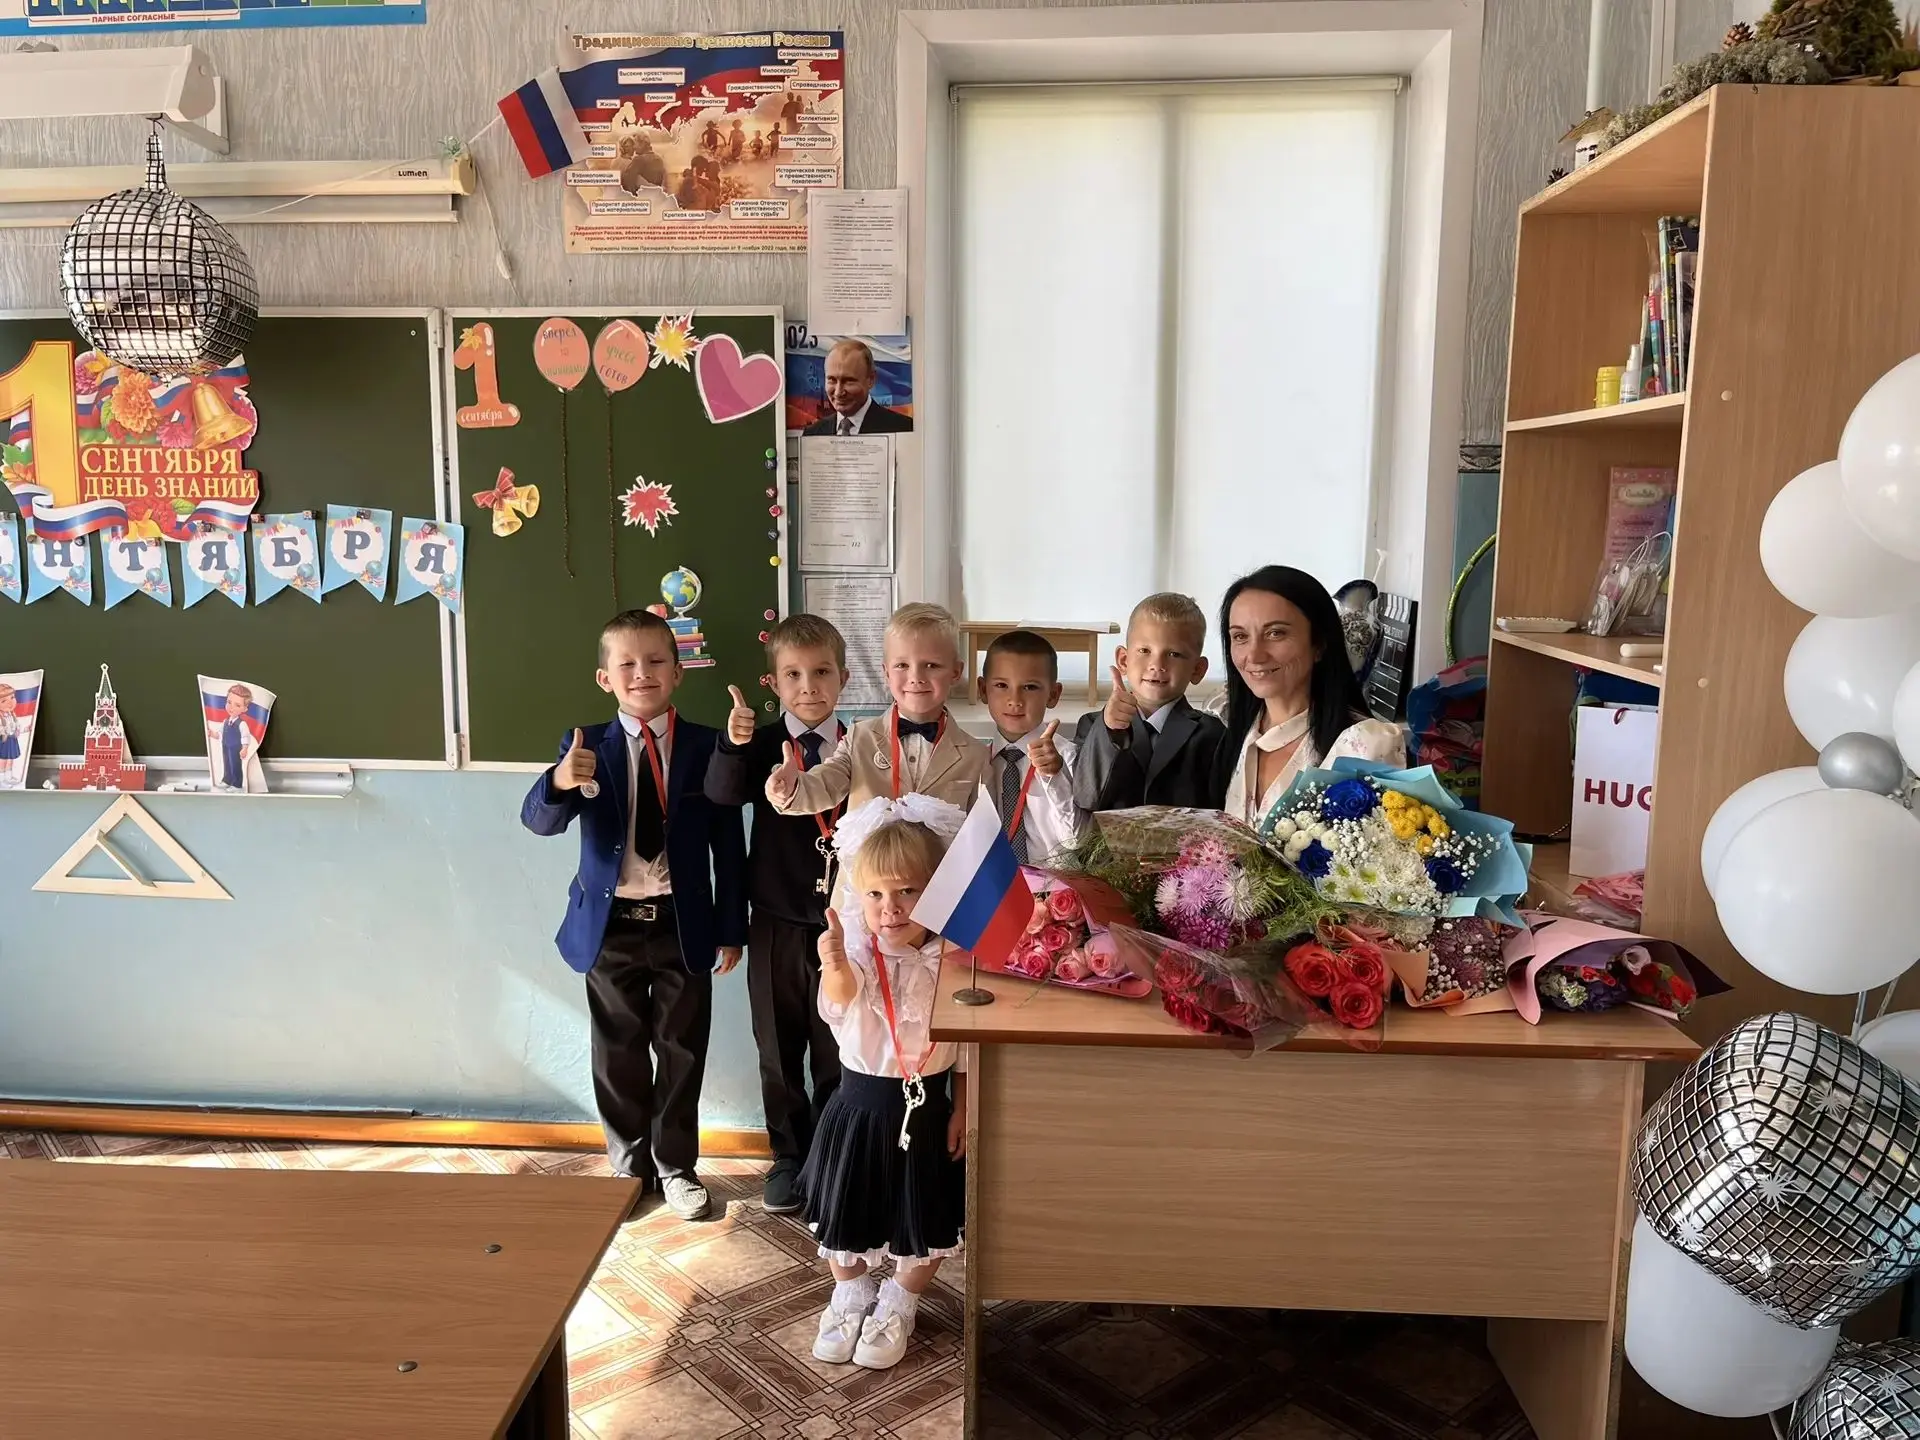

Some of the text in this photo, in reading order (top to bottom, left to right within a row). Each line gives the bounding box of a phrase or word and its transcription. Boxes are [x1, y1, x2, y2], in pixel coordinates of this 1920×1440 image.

[92, 13, 176, 23] ПАРНЫЕ СОГЛАСНЫЕ
[573, 31, 831, 50] Традиционные ценности России
[784, 325, 818, 349] 023
[0, 340, 238, 508] 1 СЕНТЯБРЯ
[461, 409, 503, 427] сентября
[84, 473, 258, 501] ДЕНЬ ЗНАНИЙ
